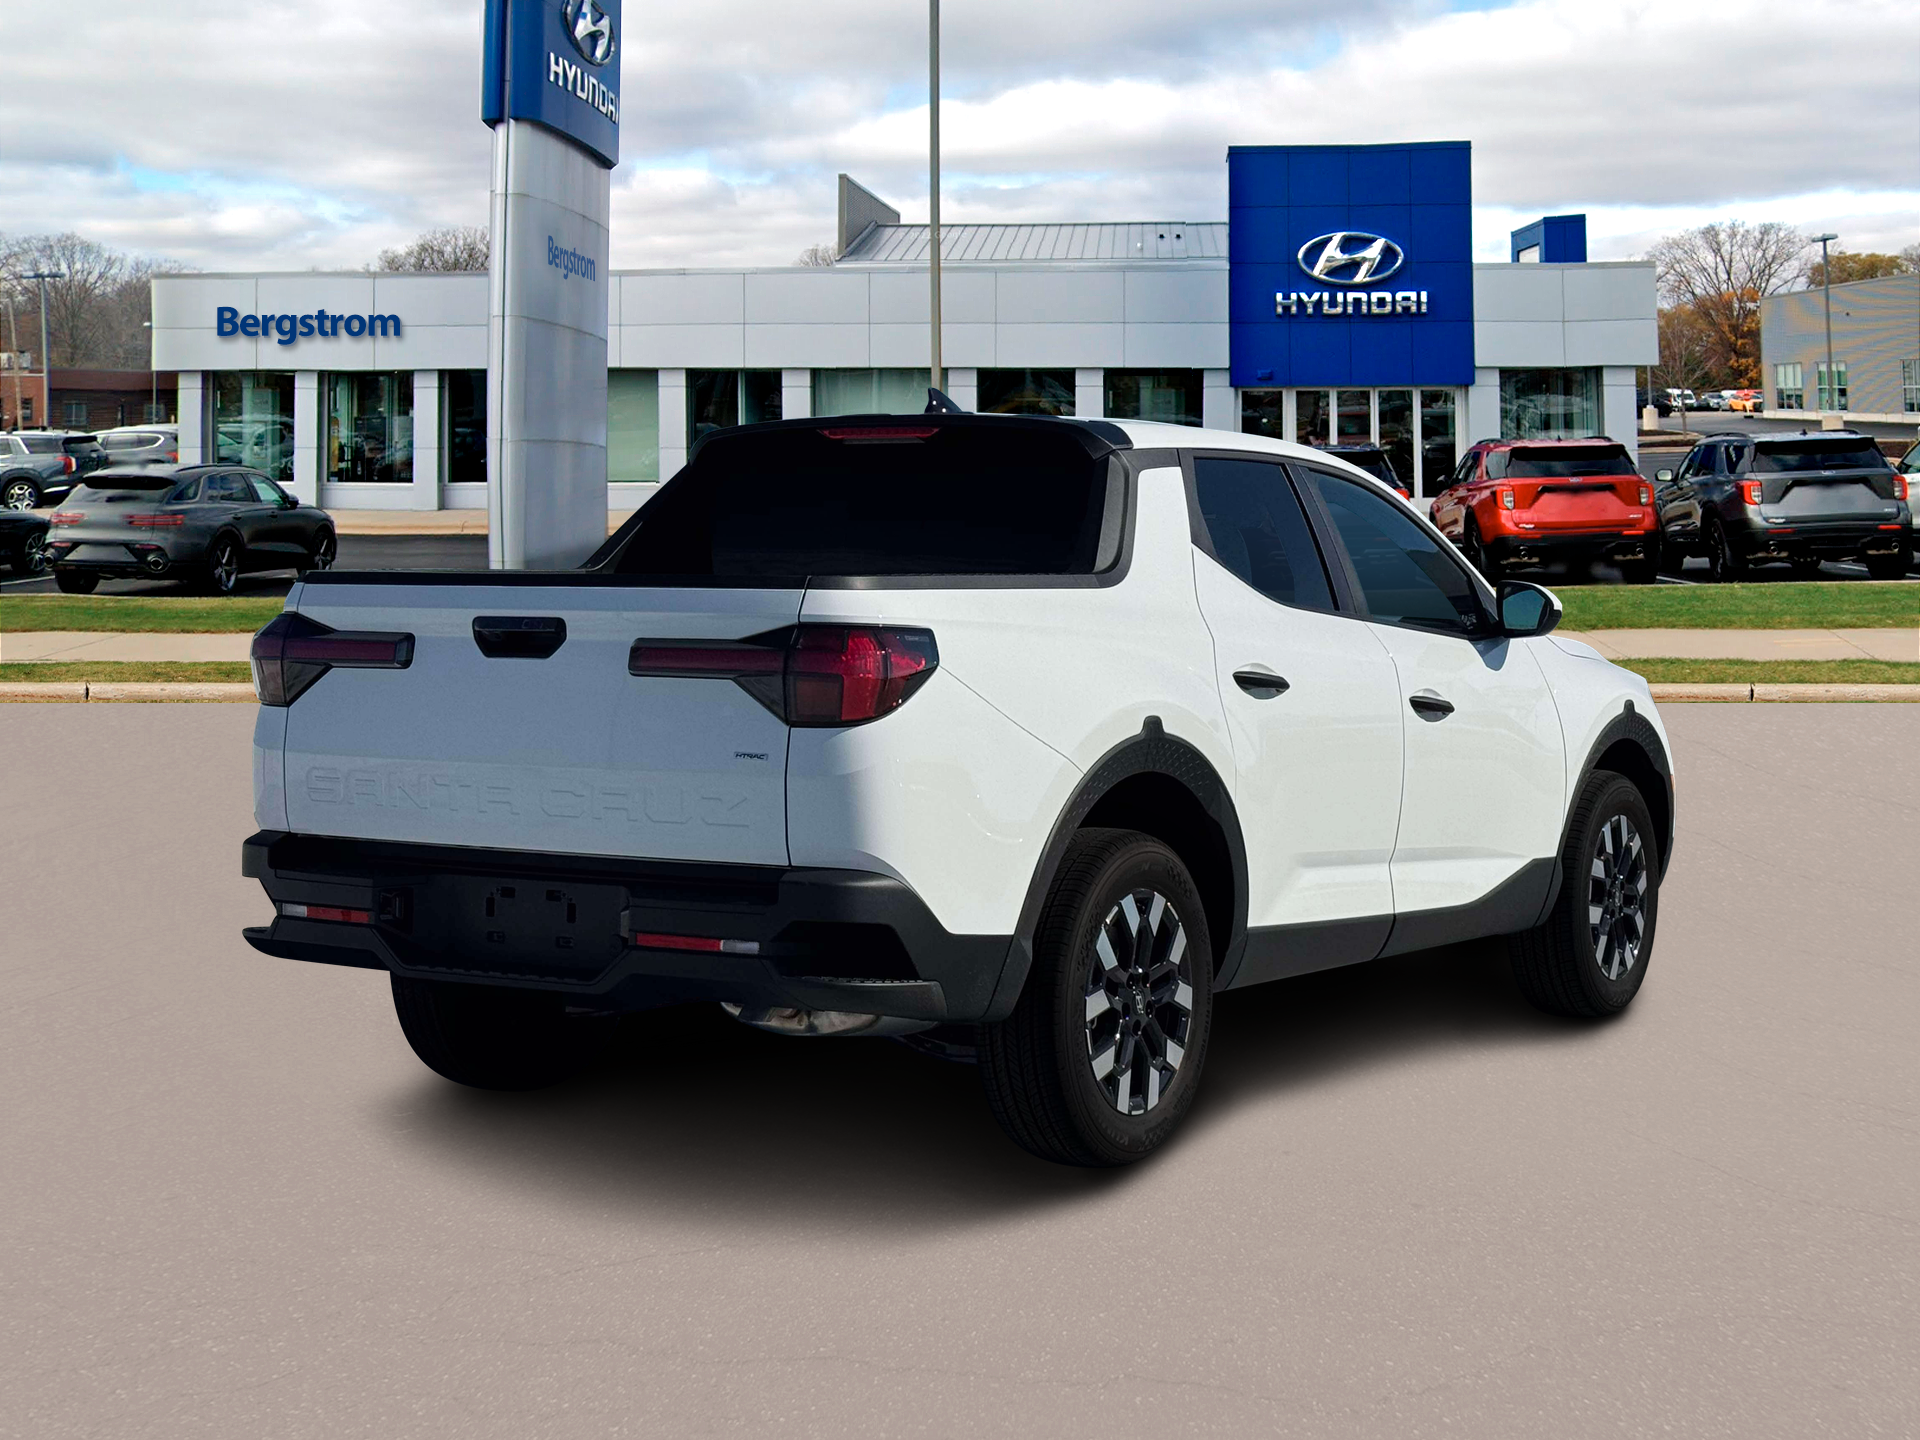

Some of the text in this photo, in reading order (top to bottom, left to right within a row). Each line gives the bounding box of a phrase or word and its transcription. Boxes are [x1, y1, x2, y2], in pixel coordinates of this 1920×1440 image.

[548, 52, 619, 124] HYUNDAI
[547, 235, 596, 282] Bergstrom
[1275, 291, 1428, 315] HYUNDAI
[217, 306, 401, 346] Bergstrom
[735, 752, 766, 760] HTRAC
[306, 766, 750, 828] SANTA CRUZ
